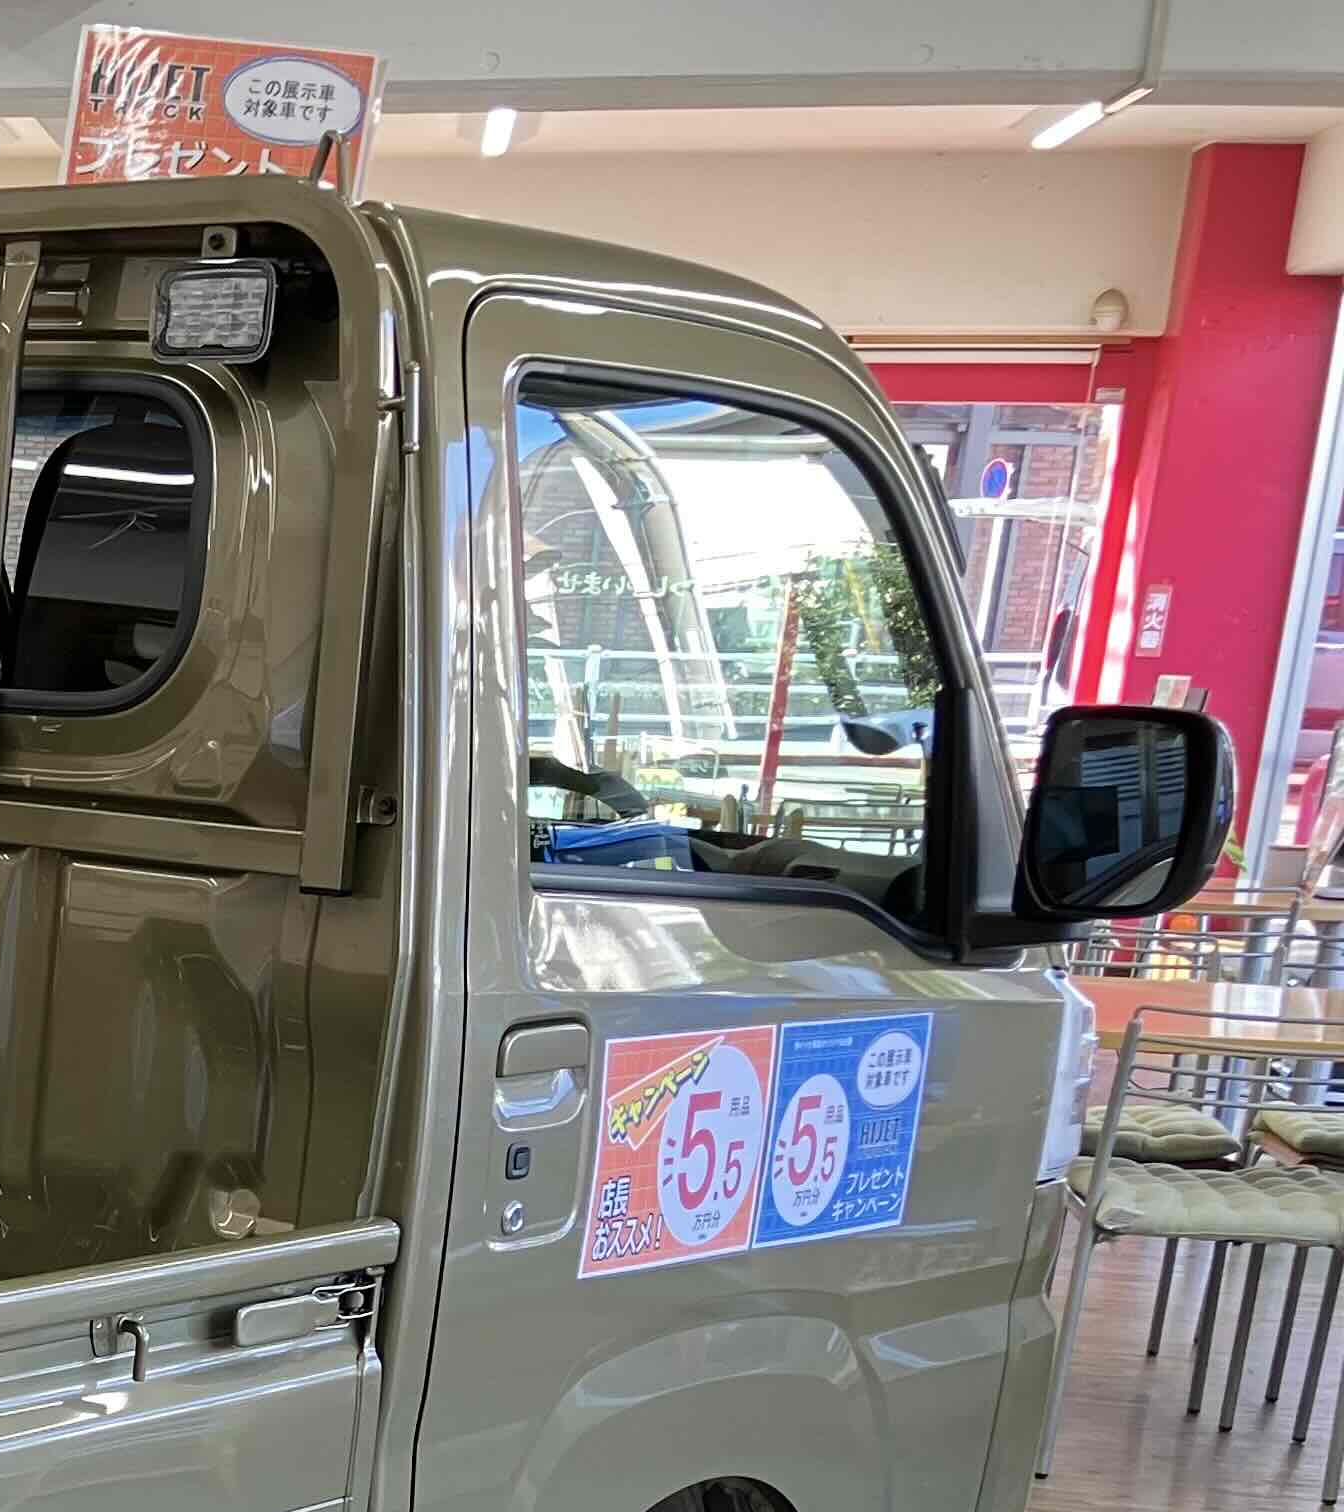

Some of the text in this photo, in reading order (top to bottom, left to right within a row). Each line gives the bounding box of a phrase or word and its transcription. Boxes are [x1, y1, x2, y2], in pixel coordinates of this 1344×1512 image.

[247, 78, 337, 102] この展示車
[89, 98, 202, 121] TRCK
[243, 98, 335, 123] 対象車です
[845, 1165, 905, 1195] プレゼント
[597, 1175, 632, 1220] 店長
[831, 1193, 902, 1221] キャンペーン
